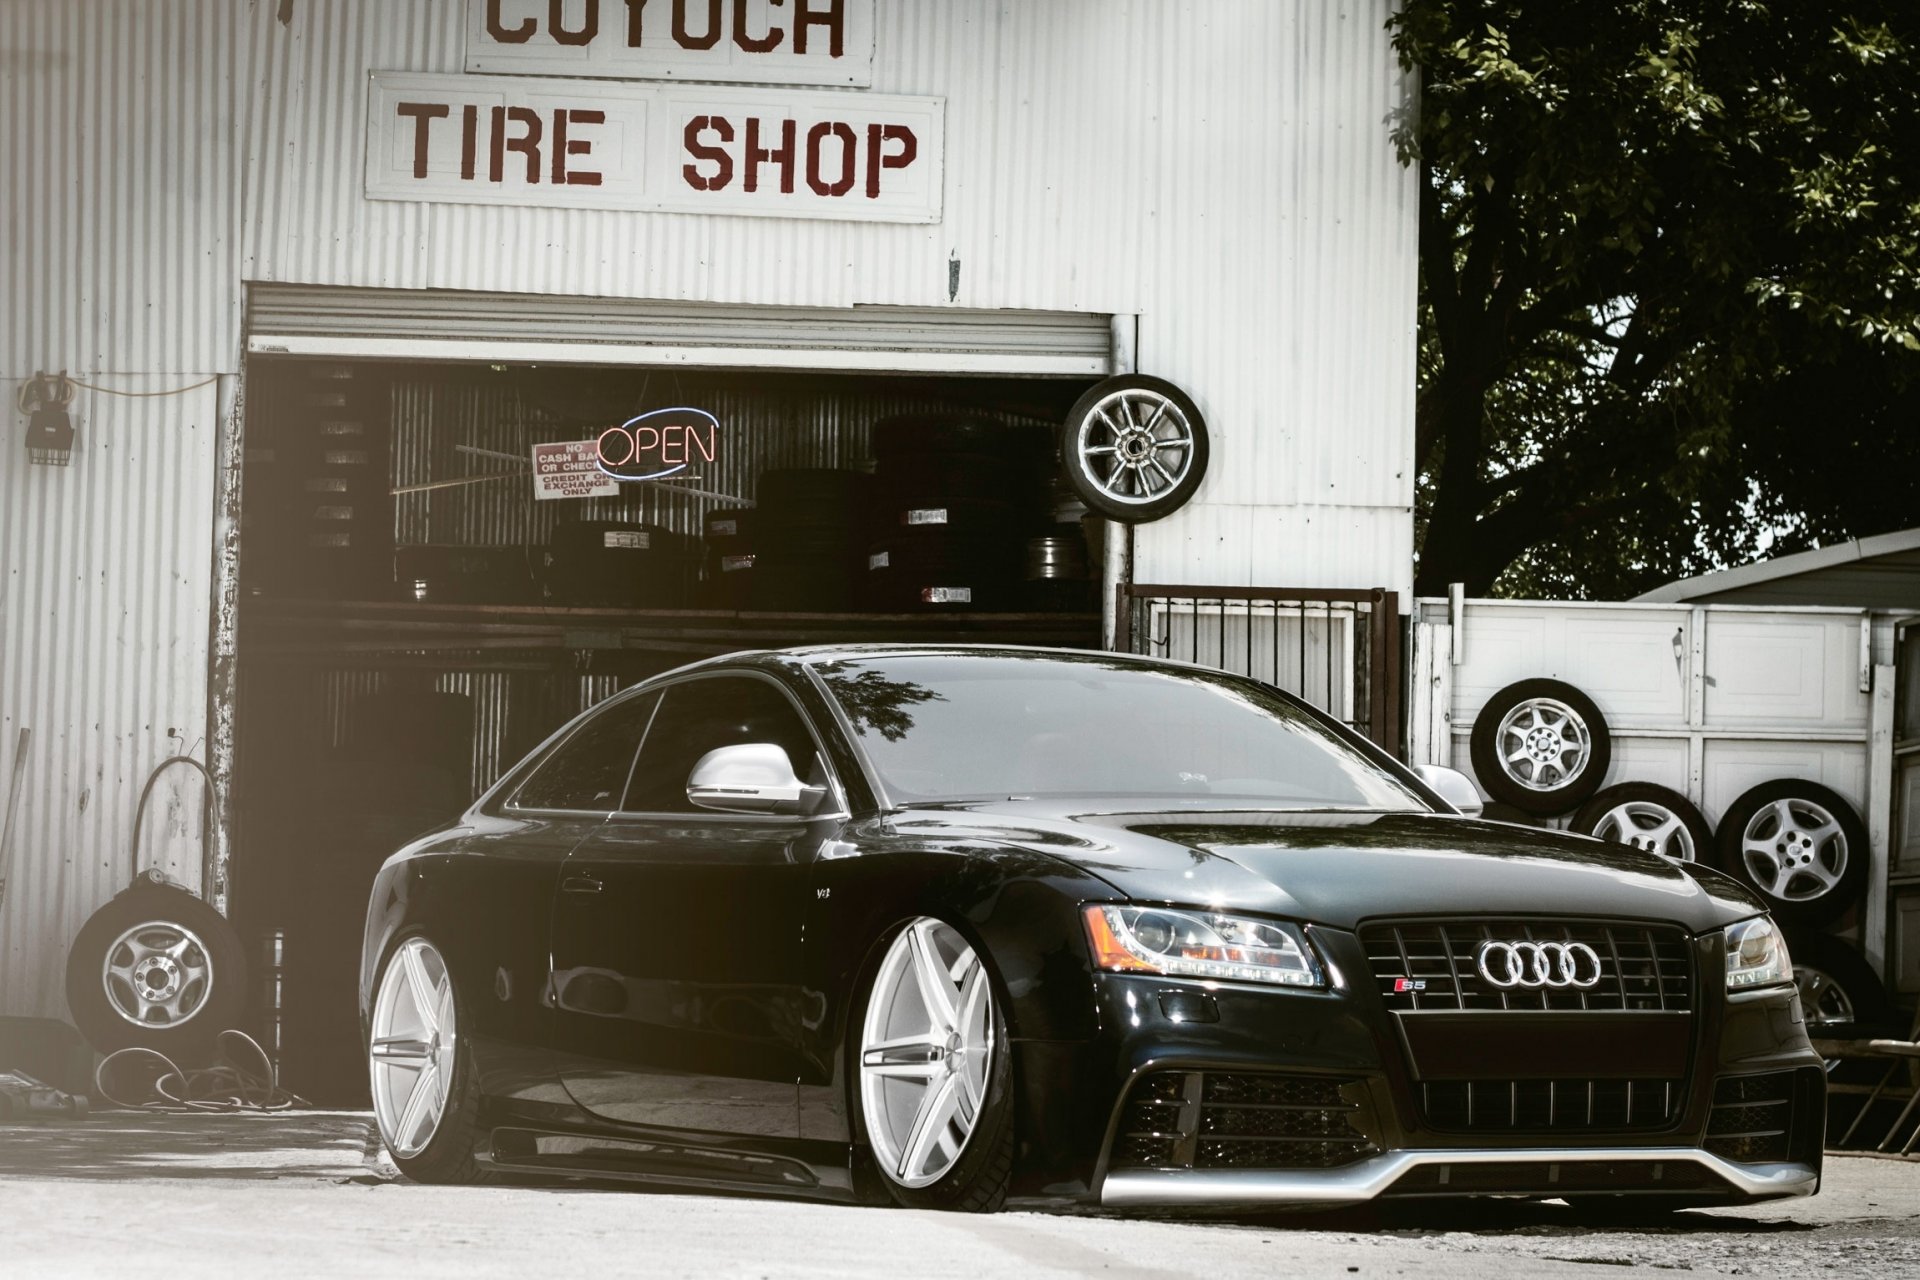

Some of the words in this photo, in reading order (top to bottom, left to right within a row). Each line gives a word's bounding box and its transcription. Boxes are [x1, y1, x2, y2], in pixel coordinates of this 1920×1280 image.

[397, 102, 606, 185] TIRE
[683, 115, 918, 198] SHOP
[566, 444, 583, 453] NO
[597, 424, 715, 467] OPEN
[538, 453, 571, 463] CASH
[541, 463, 558, 473] OR
[542, 474, 588, 483] CREDIT
[543, 480, 610, 490] EXCHANGE
[562, 488, 592, 496] ONLY
[1401, 980, 1427, 990] S5
